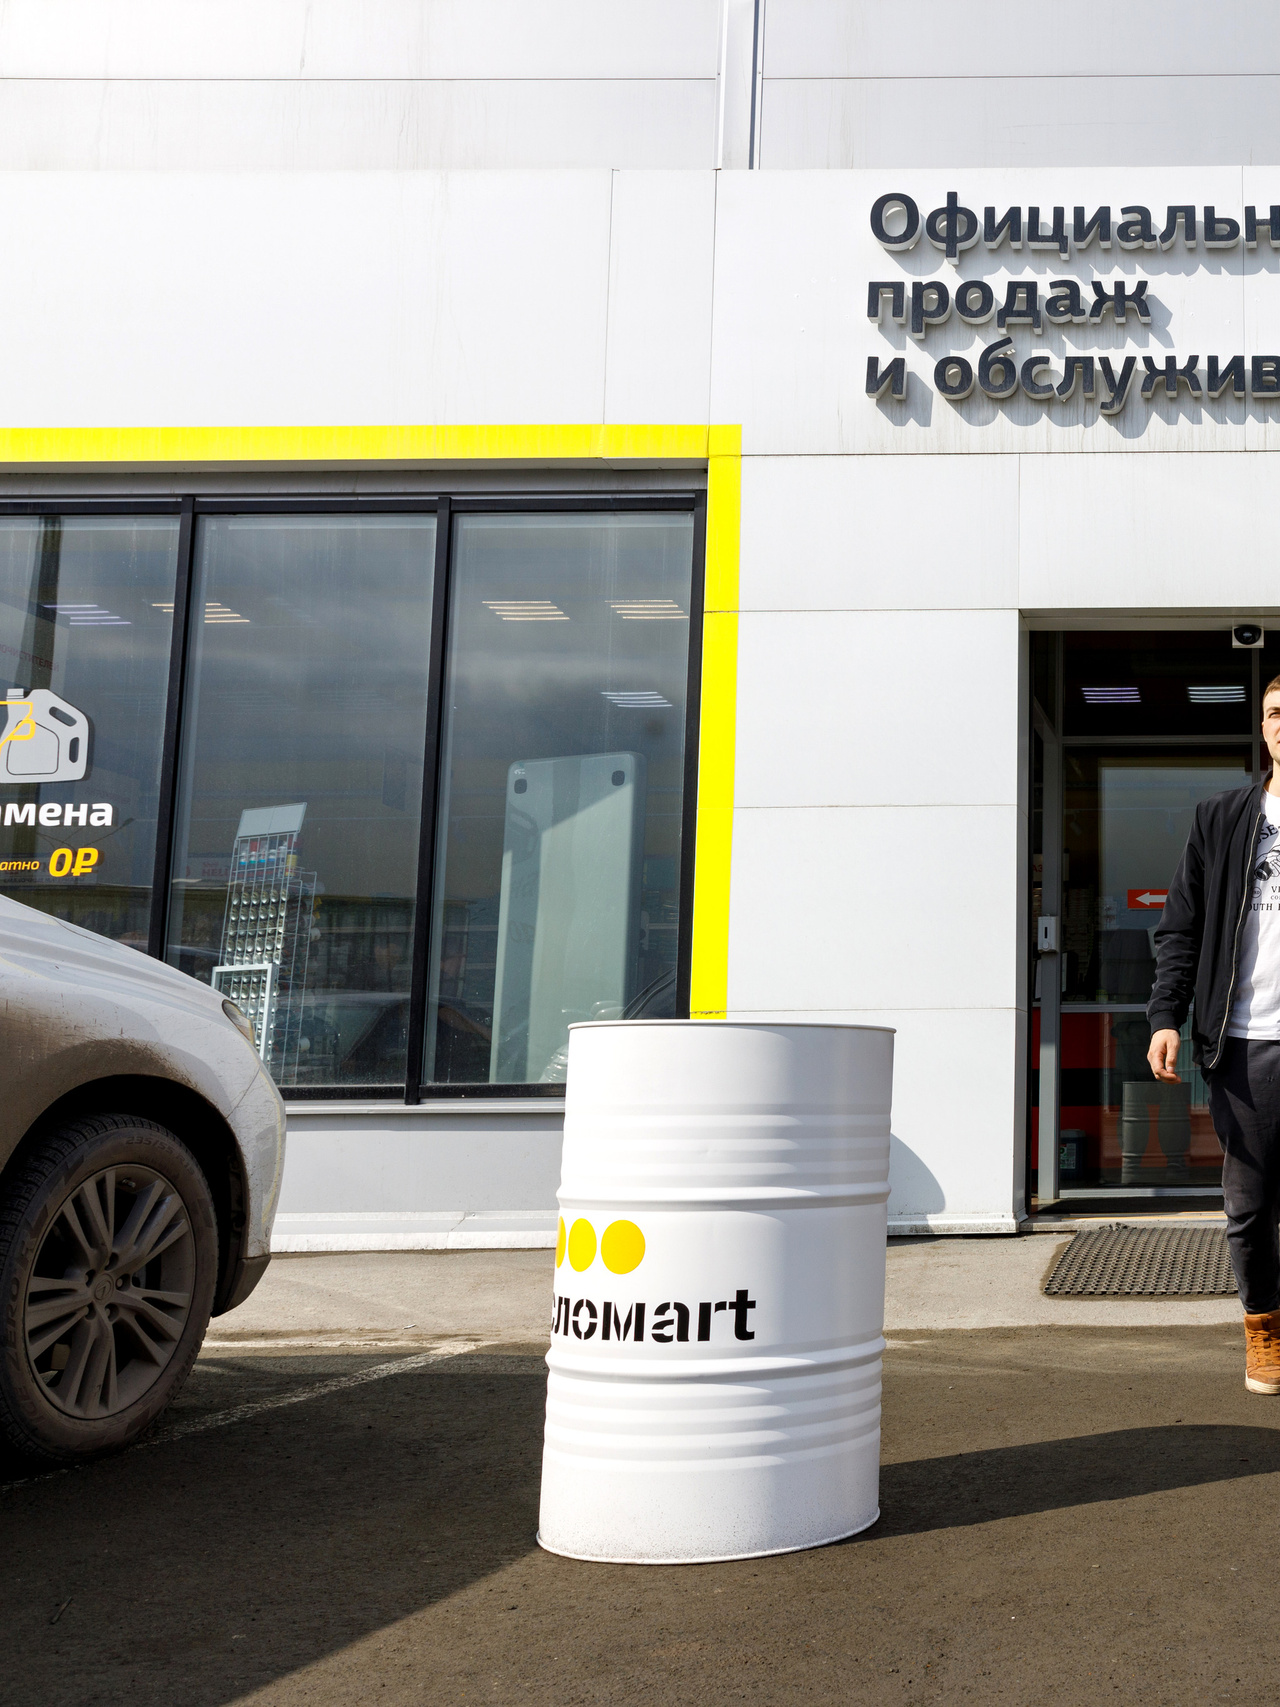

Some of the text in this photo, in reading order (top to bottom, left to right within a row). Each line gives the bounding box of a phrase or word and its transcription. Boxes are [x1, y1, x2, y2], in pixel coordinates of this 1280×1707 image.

[867, 279, 1151, 338] продаж
[865, 354, 907, 398] и
[0, 802, 113, 827] мена
